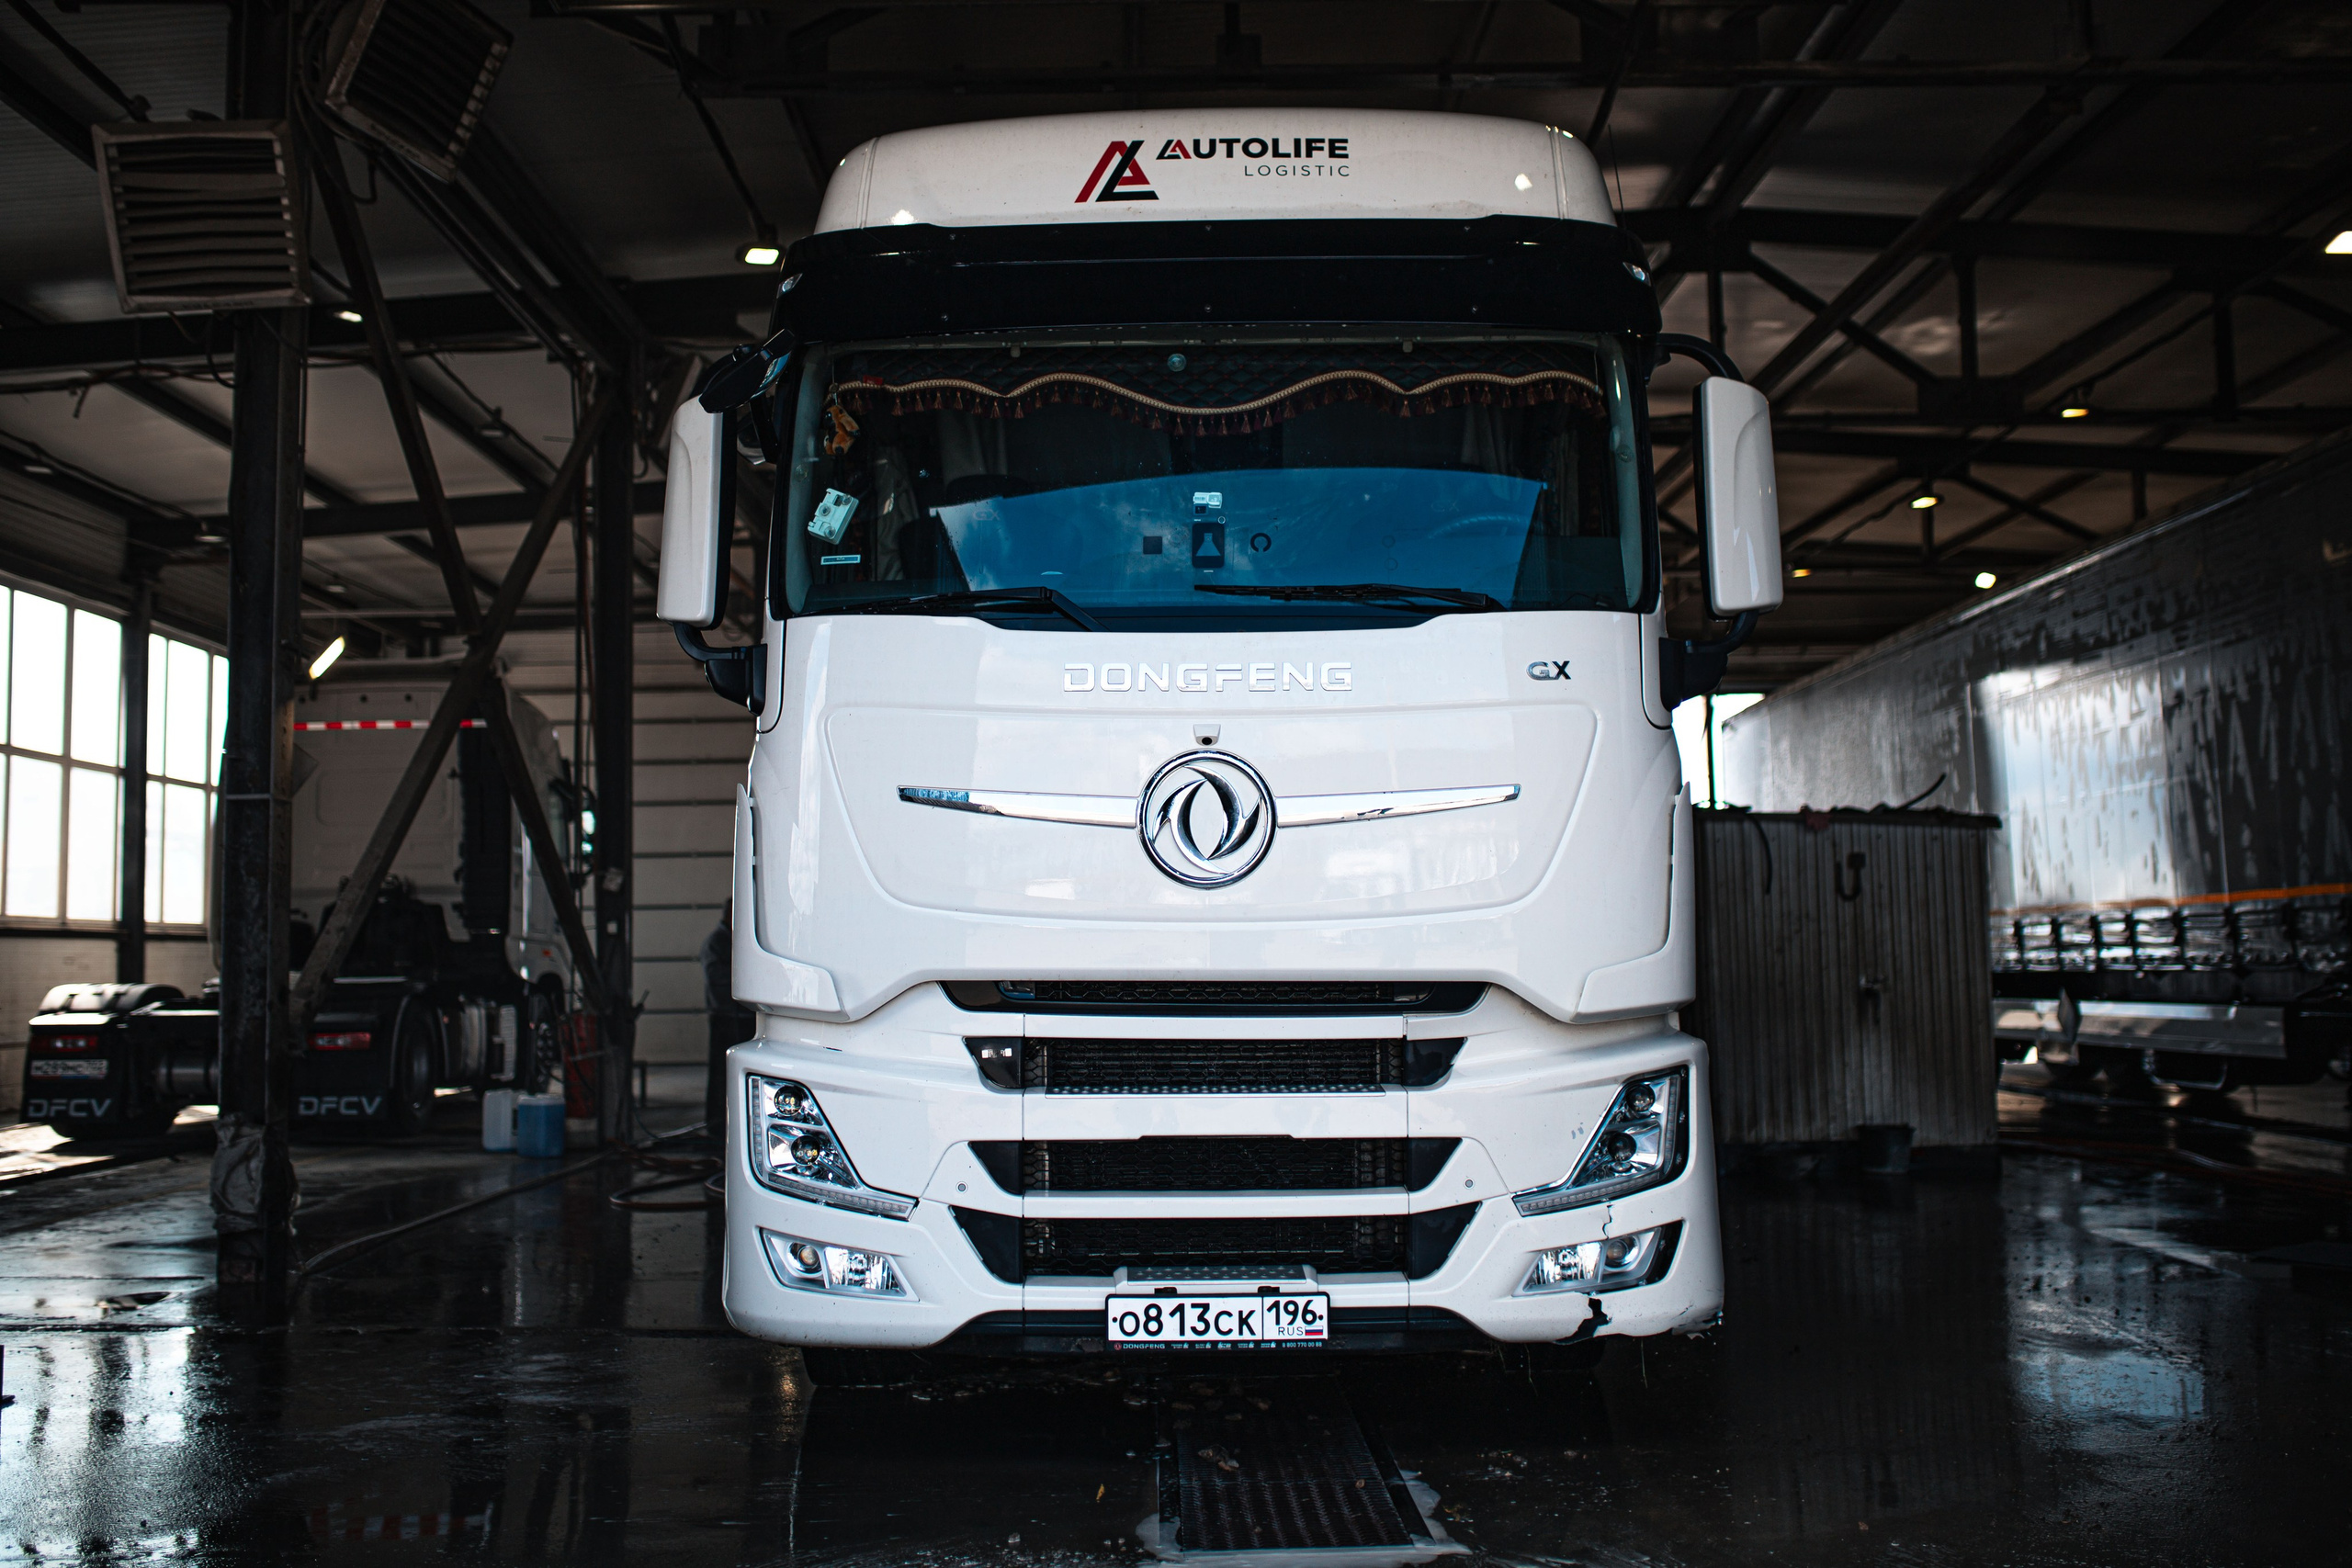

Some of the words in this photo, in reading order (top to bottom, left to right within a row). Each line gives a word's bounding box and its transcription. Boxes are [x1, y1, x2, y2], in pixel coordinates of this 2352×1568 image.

[1156, 137, 1350, 160] AUTOLIFE
[1244, 164, 1351, 177] LOGISTIC
[1063, 661, 1352, 693] DONGFENG
[1525, 660, 1572, 682] GX
[27, 1098, 112, 1118] DFCV
[297, 1095, 383, 1116] DFCV
[1266, 1299, 1317, 1326] 196
[1277, 1326, 1304, 1336] RUS
